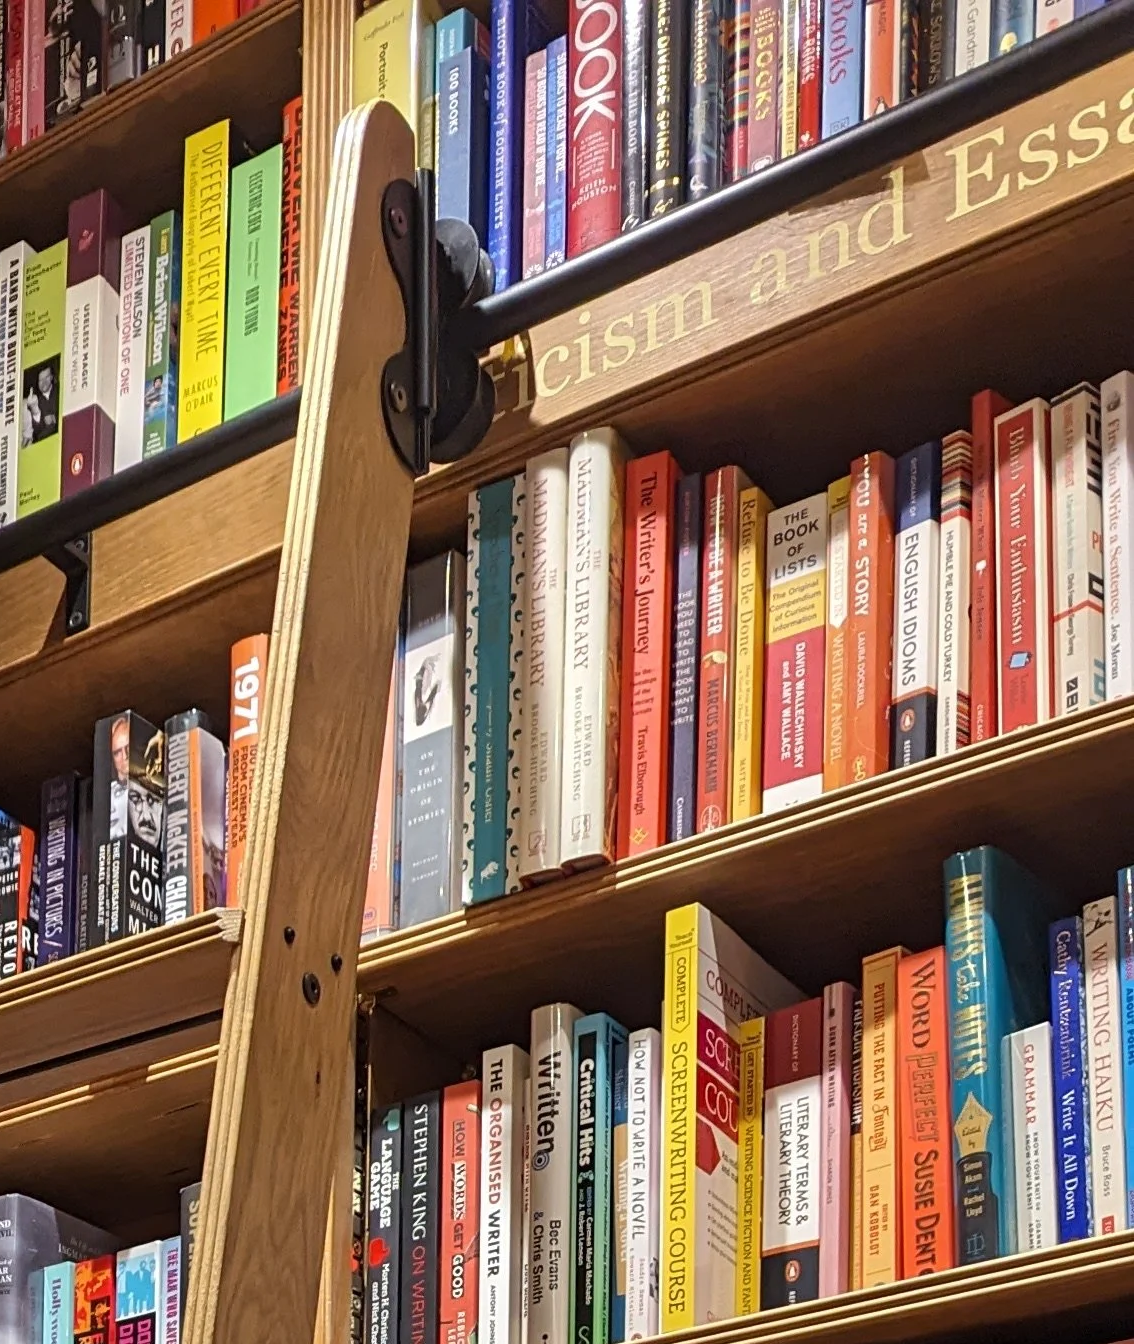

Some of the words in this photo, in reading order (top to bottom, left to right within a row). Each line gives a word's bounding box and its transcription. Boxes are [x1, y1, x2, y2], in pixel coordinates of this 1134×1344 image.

[199, 141, 223, 247] DIFFERENT
[134, 236, 146, 281] STEVEN
[747, 171, 914, 308] and
[197, 248, 219, 308] EVERY
[132, 283, 145, 340] WILSON
[195, 313, 218, 361] TIME
[640, 471, 660, 507] The
[783, 508, 809, 526] THE
[773, 518, 820, 546] BOOK
[786, 542, 804, 558] OF
[774, 554, 818, 580] LISTS
[902, 531, 920, 616] ENGLISH
[633, 586, 658, 656] Journey
[901, 617, 917, 687] IDIOMS
[234, 656, 259, 740] 1971
[910, 959, 937, 1049] WORD
[669, 1041, 689, 1224] SCREENWRITING
[913, 1150, 939, 1209] SUSIE
[668, 1226, 687, 1315] COURSE
